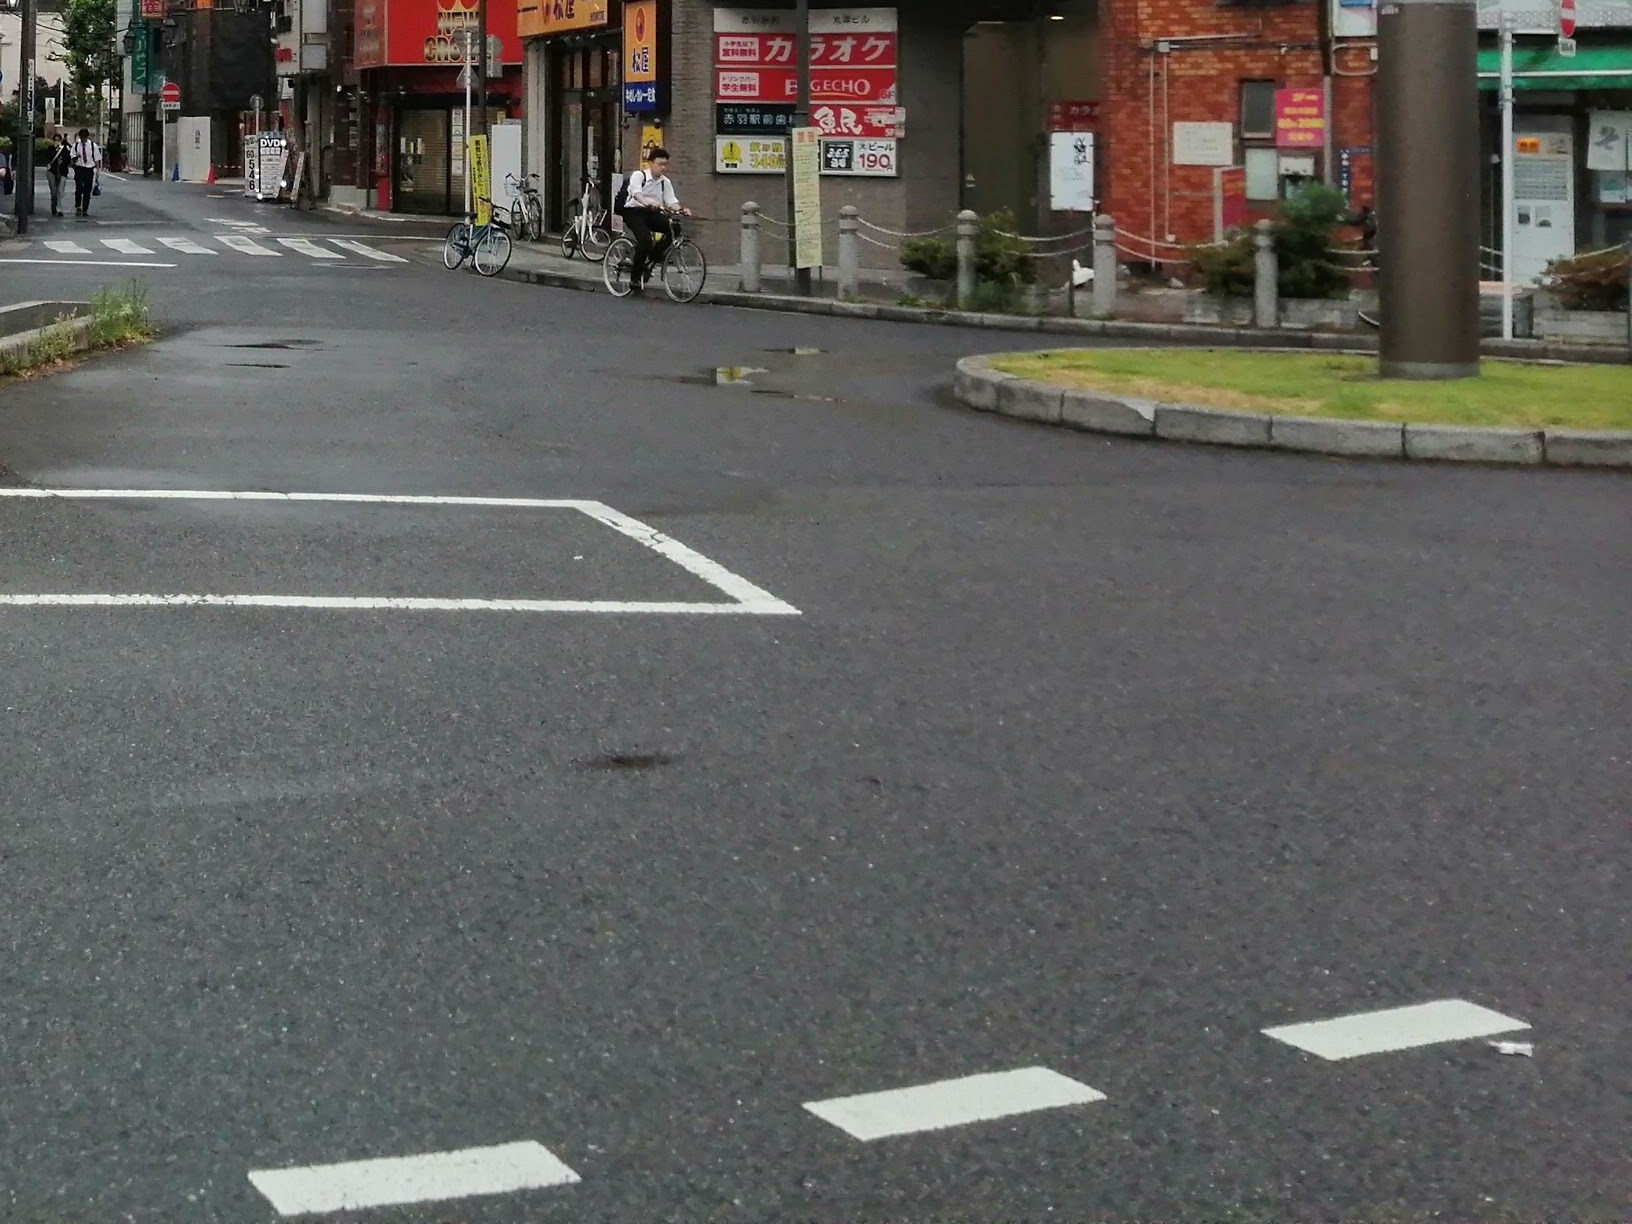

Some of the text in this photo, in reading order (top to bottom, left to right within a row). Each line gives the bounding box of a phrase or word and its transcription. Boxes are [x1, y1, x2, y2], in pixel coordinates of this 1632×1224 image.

[764, 36, 891, 63] カラオケ
[825, 79, 871, 95] ECHO
[260, 139, 280, 147] DVD
